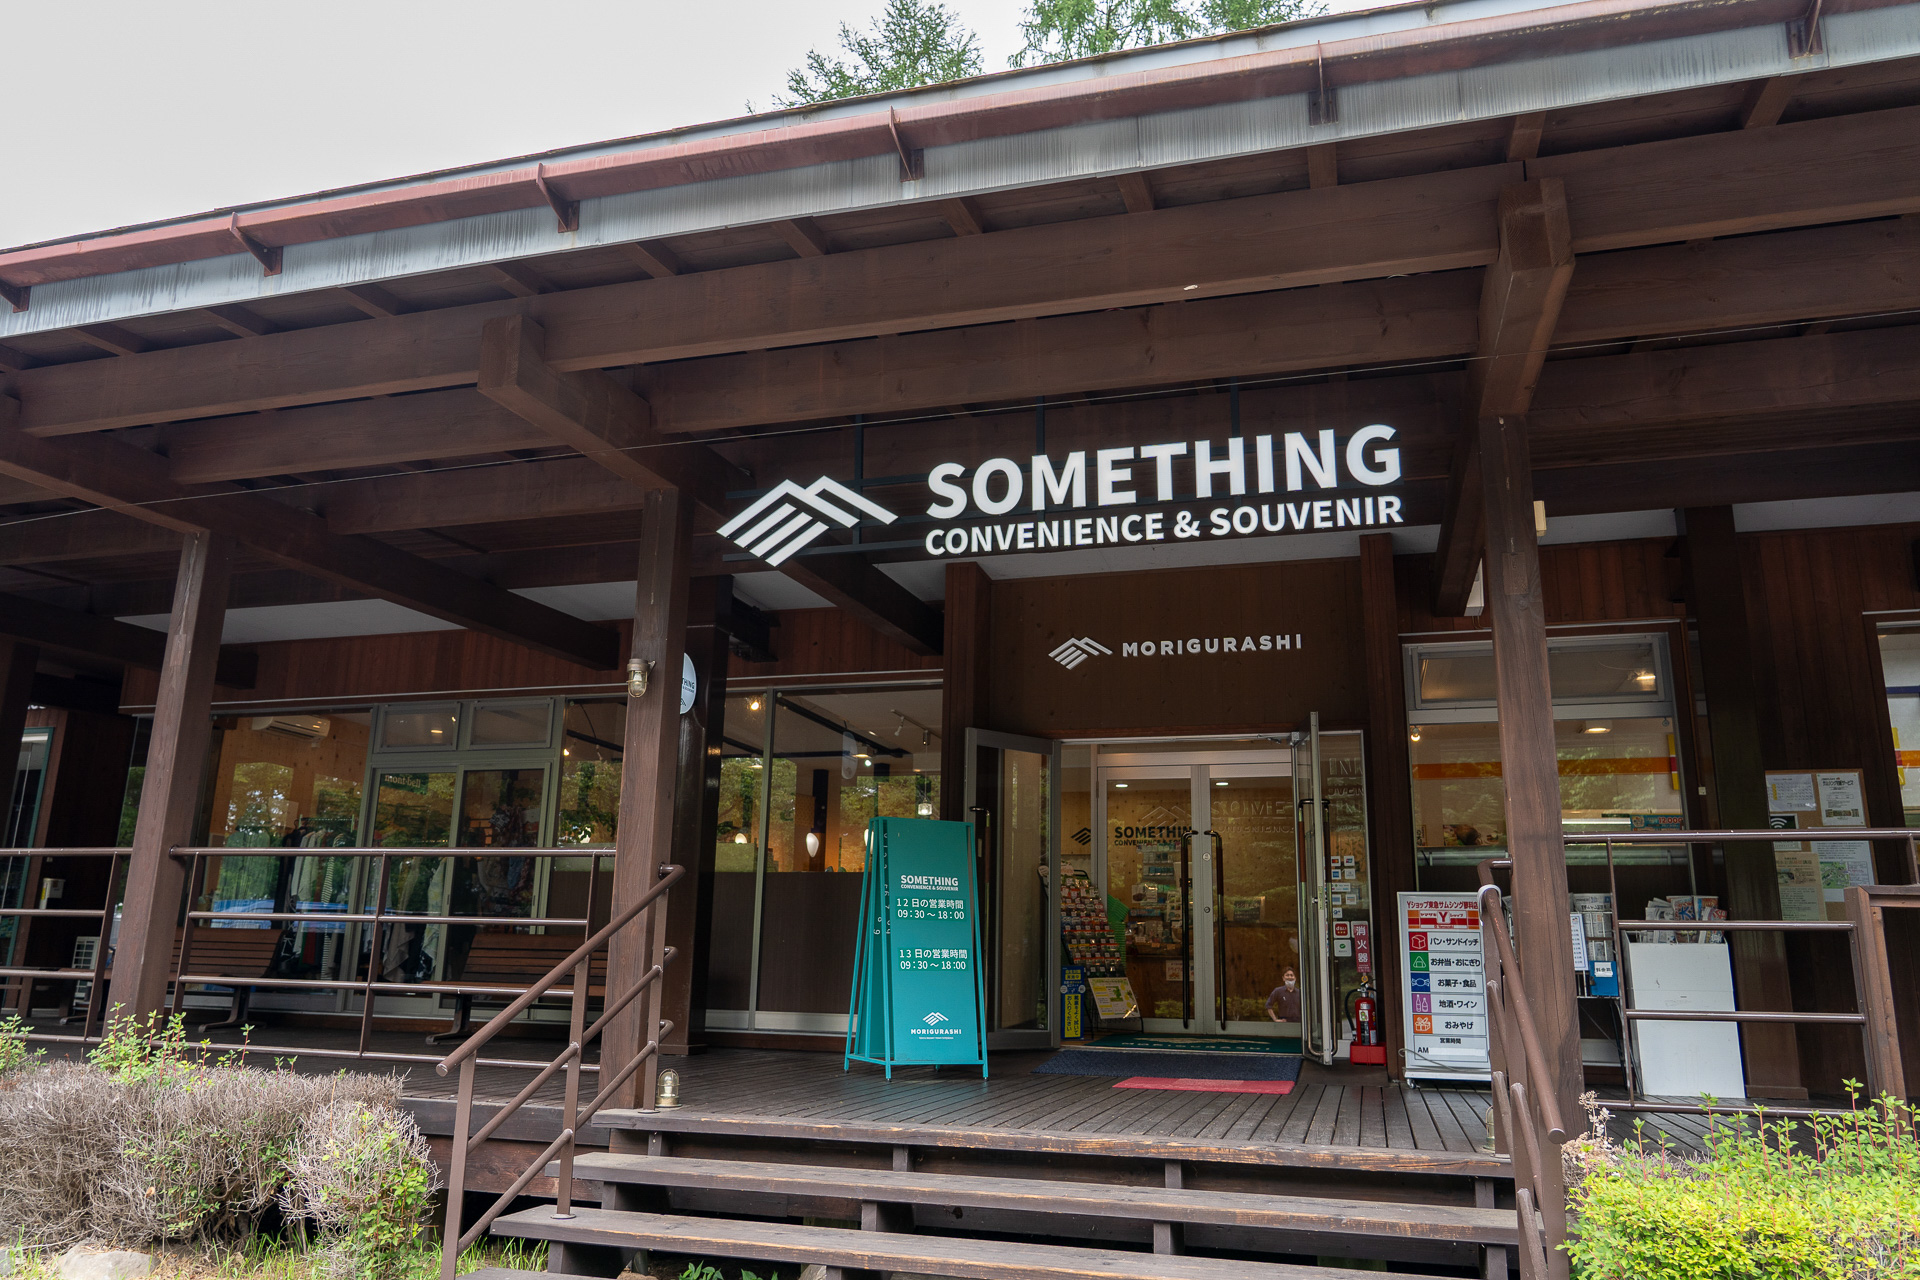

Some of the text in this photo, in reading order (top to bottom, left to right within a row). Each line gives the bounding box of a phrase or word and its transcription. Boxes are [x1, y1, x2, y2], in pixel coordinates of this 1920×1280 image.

[926, 424, 1402, 519] SOMETHING
[925, 495, 1404, 556] CONVENIENCE & SOUVENIR
[1122, 634, 1302, 657] MORIGURASHI
[1114, 826, 1192, 839] SOMETHIN
[900, 875, 959, 886] SOMETHING
[1438, 911, 1448, 922] Y
[1355, 926, 1368, 963] 消火器
[1429, 937, 1479, 946] パン・サンドイッチ
[1430, 957, 1481, 967] お弁当・おにぎり
[1437, 979, 1477, 988] お菓子・食品
[1438, 1000, 1477, 1009] 地酒・ワイン
[1444, 1021, 1474, 1030] おみやげ
